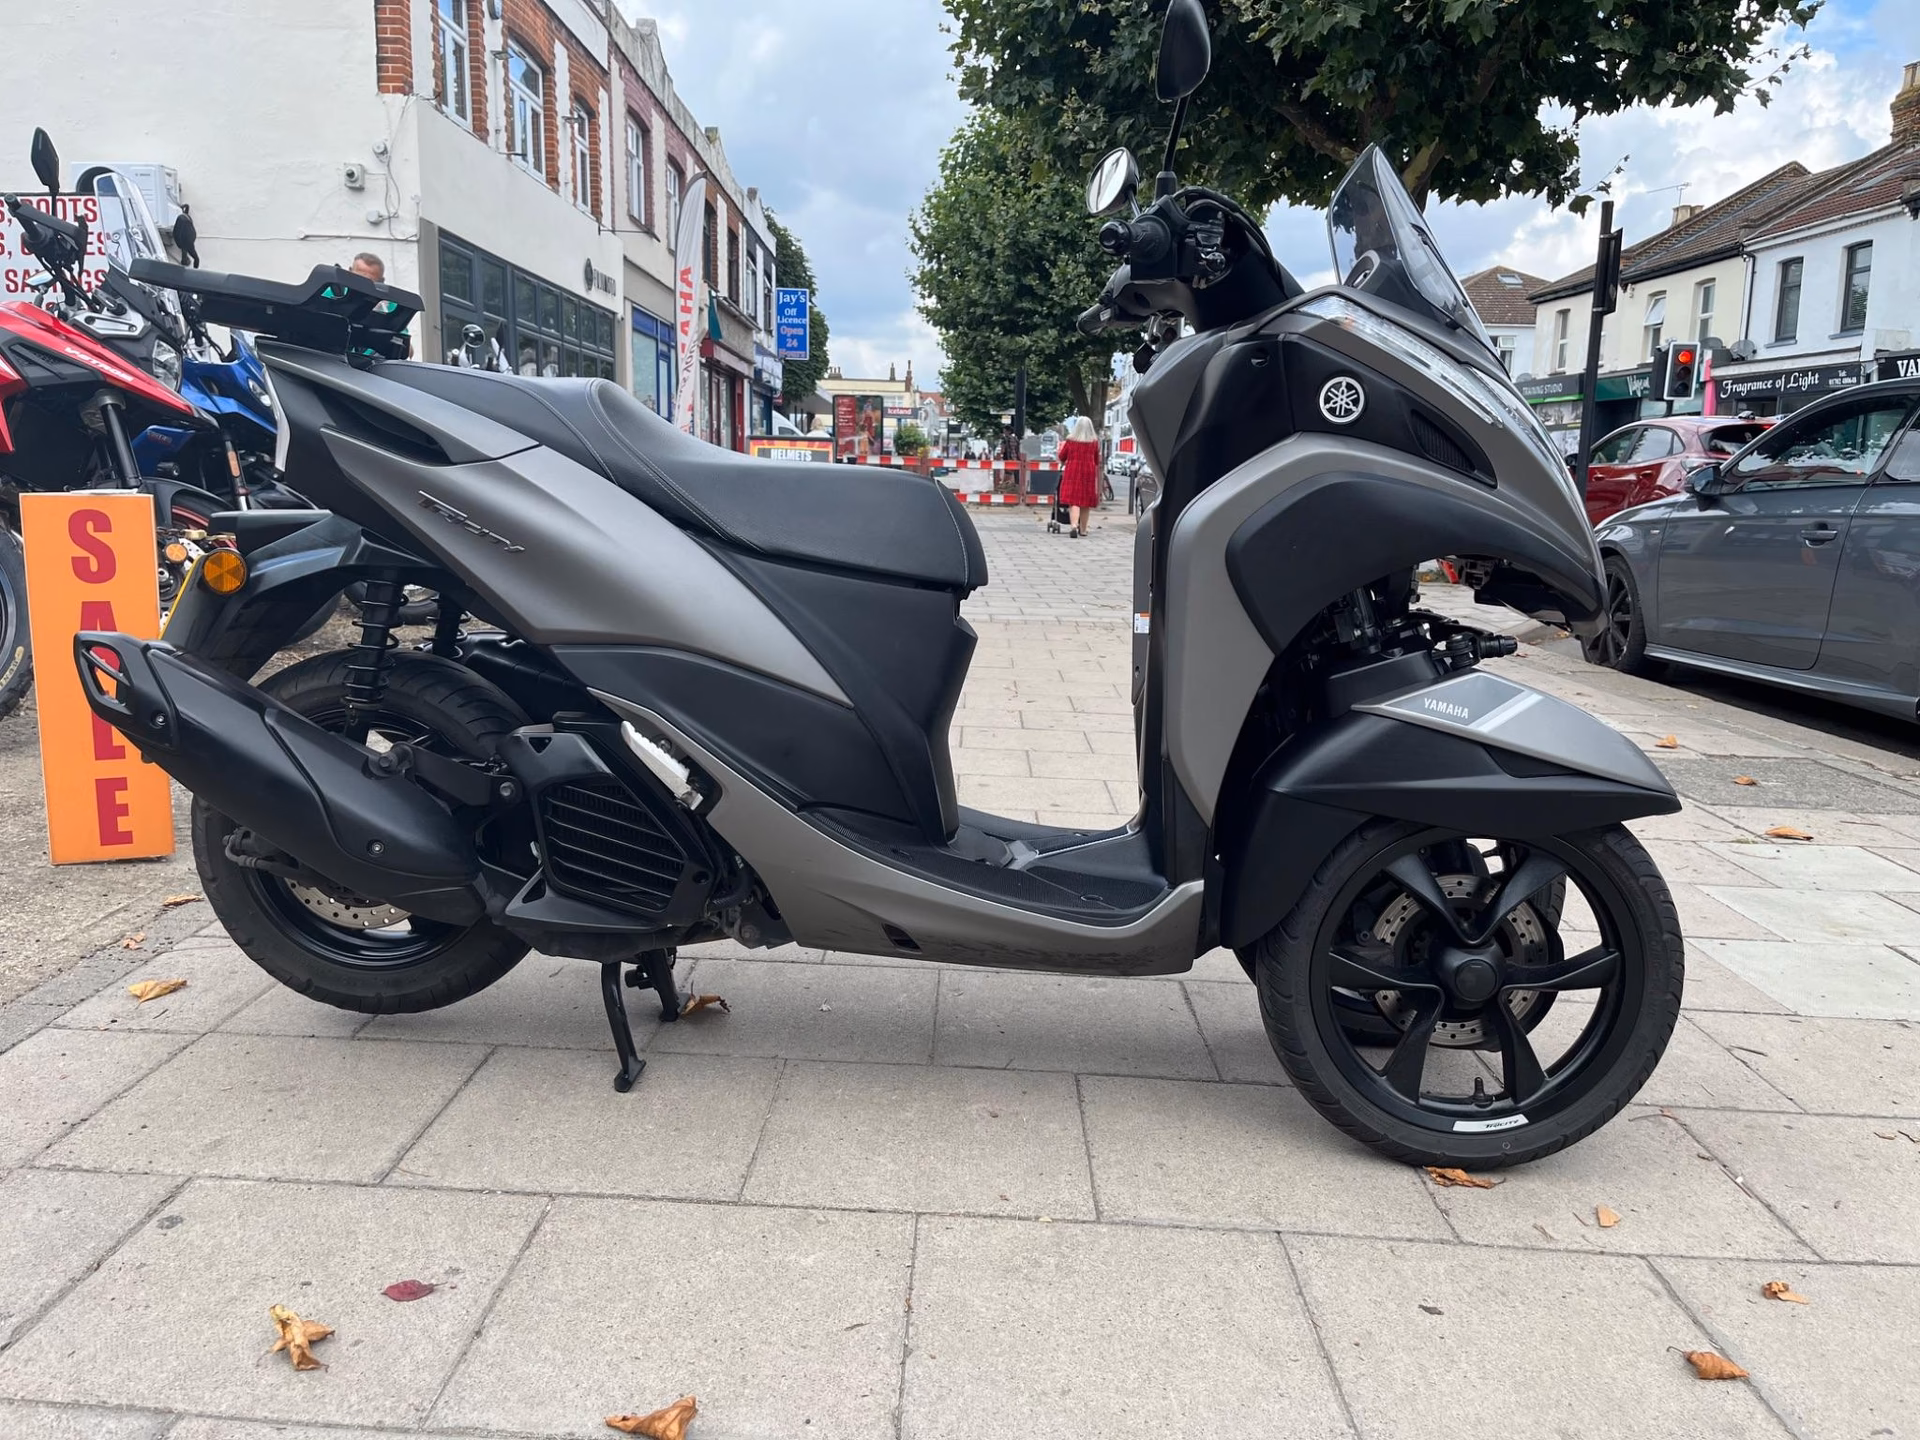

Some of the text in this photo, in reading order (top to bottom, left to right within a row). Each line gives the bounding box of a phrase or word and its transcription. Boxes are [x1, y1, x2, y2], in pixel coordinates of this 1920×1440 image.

[779, 291, 806, 305] Jay's
[784, 307, 798, 316] Off
[777, 315, 807, 324] Licence
[786, 338, 798, 348] 24
[1522, 383, 1563, 396] TRAINING STUDIO
[1720, 371, 1819, 398] Fragrance of Light
[770, 448, 812, 461] HELMETS
[1423, 697, 1469, 719] YAMAHA
